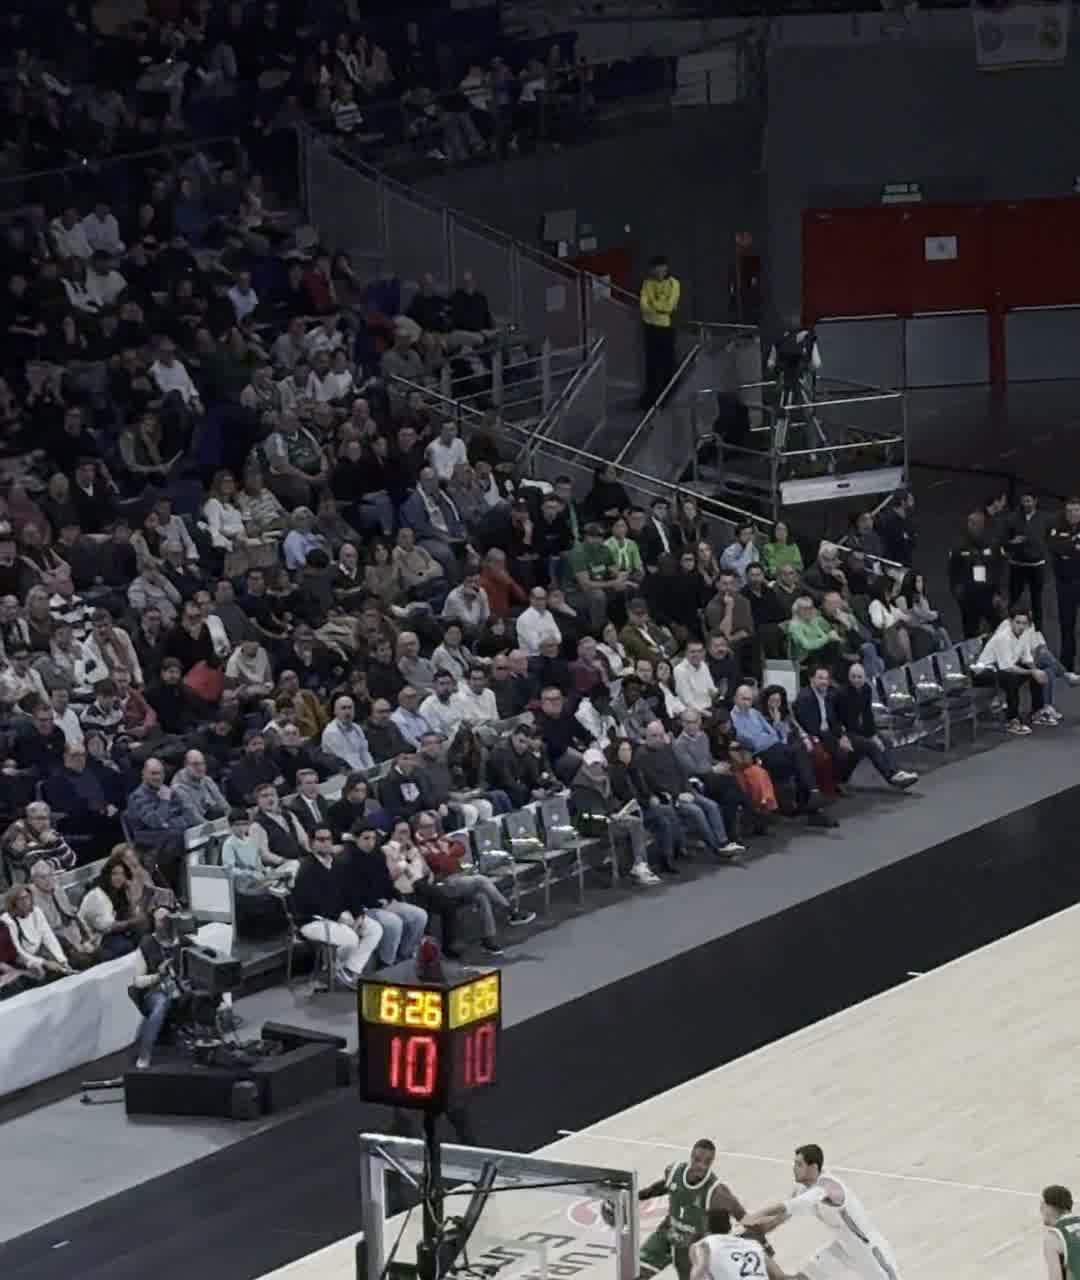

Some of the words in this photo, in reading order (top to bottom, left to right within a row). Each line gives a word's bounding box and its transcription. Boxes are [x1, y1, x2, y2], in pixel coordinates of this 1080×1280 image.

[380, 985, 442, 1026] 6:26
[390, 1036, 437, 1095] 10
[465, 1023, 495, 1086] 10
[731, 1251, 764, 1277] 22
